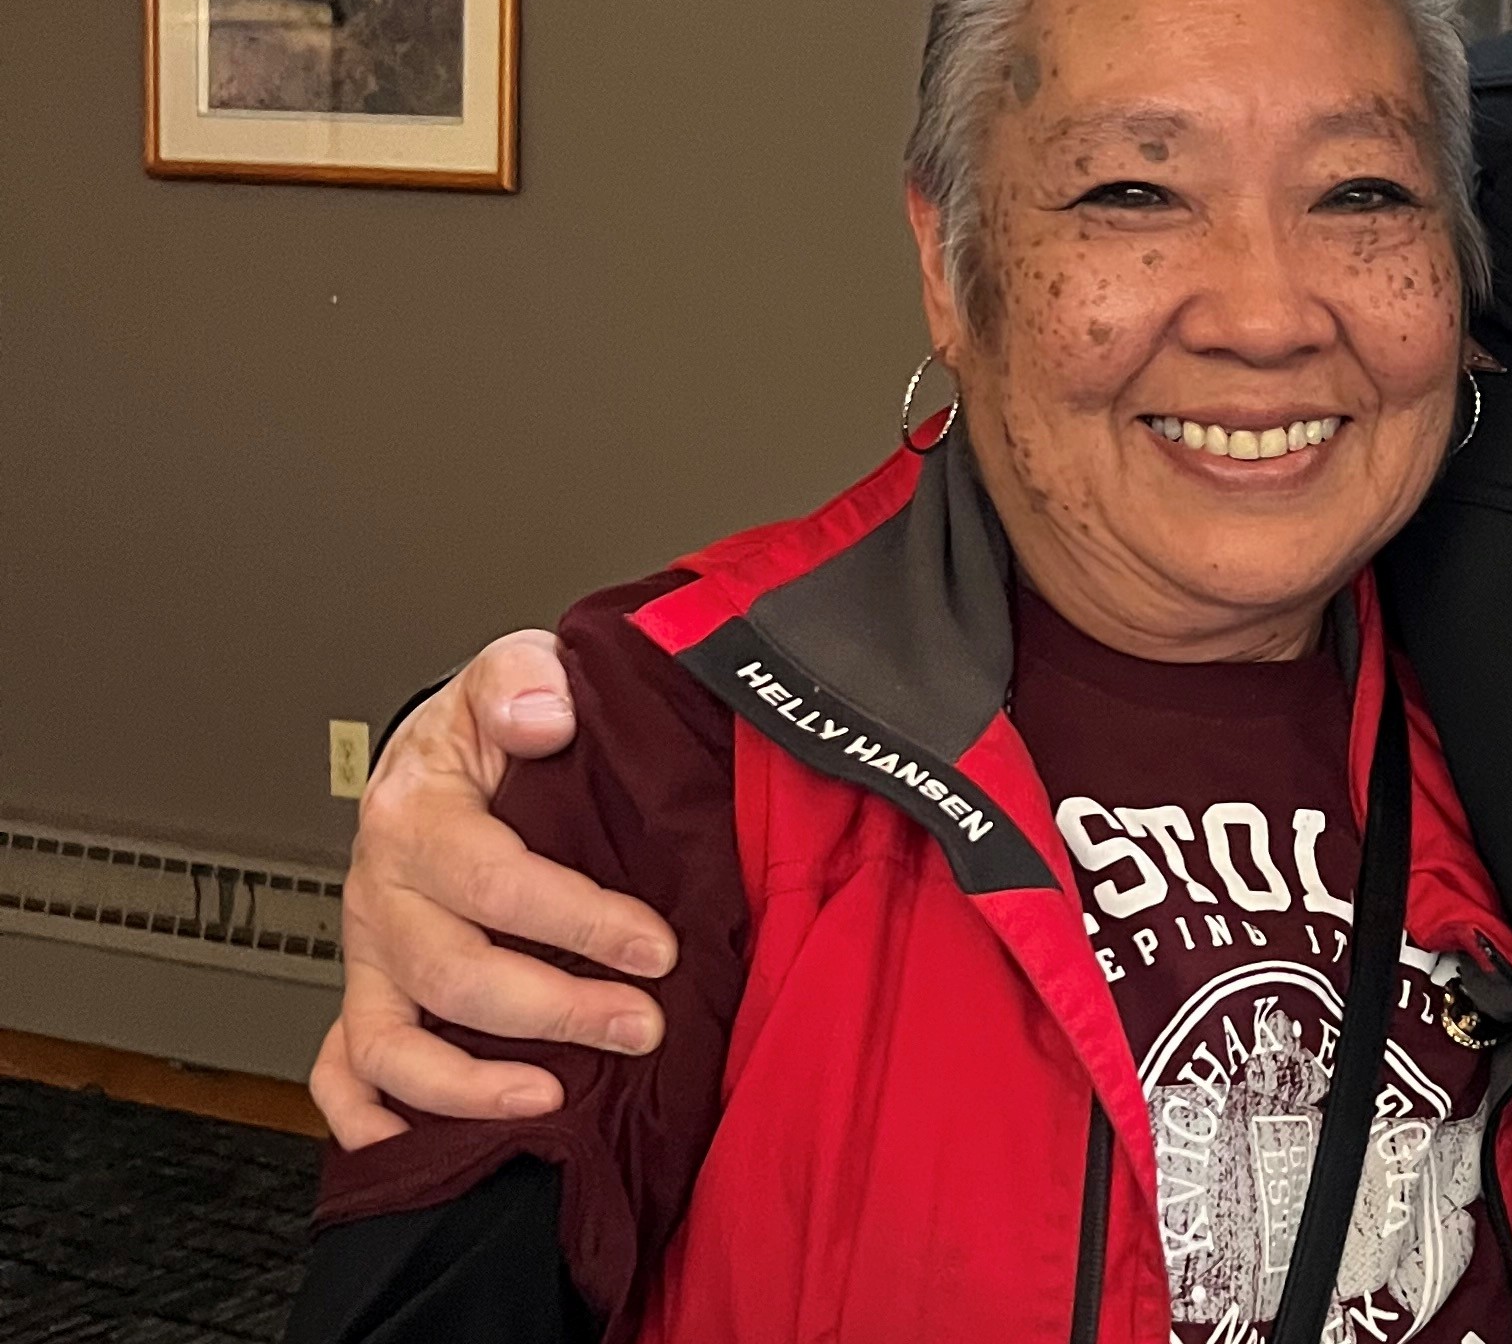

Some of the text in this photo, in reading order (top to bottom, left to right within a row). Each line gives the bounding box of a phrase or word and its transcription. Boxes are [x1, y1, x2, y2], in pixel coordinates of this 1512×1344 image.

[735, 660, 995, 843] HELLY HANSEN
[1055, 795, 1355, 936] STOL
[1094, 913, 1268, 983] EPING
[1155, 995, 1283, 1268] KVICHAK
